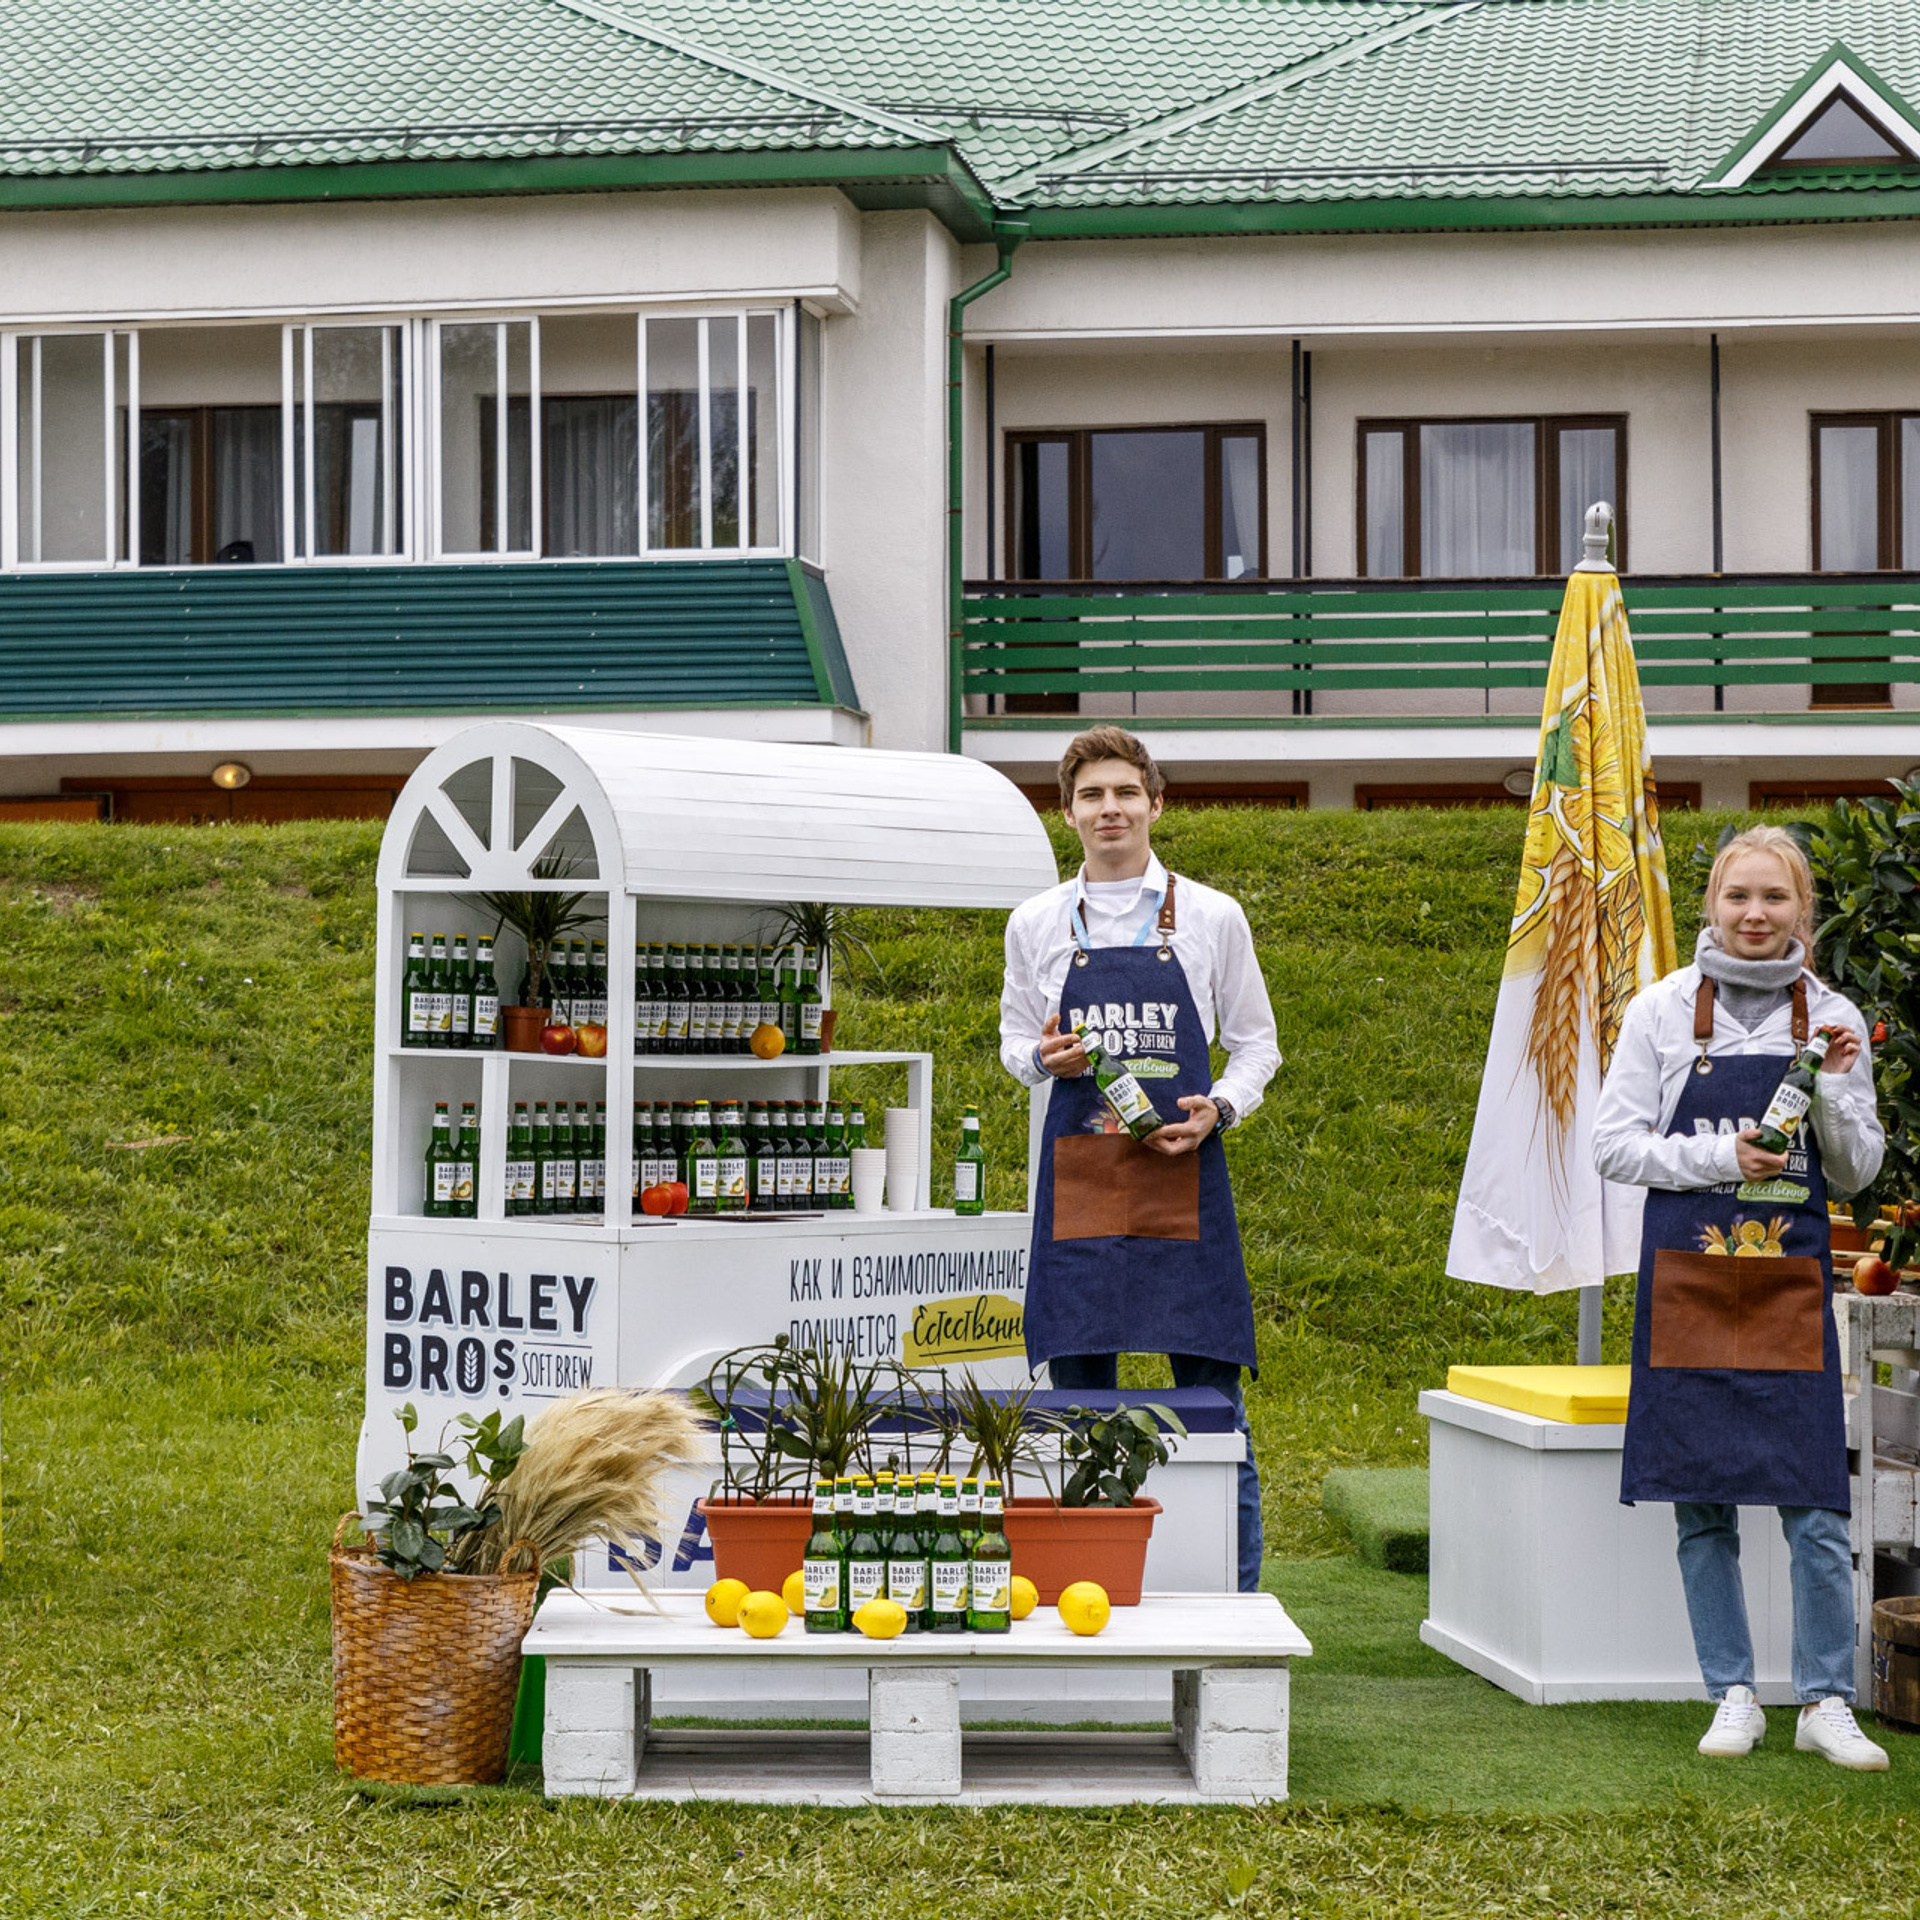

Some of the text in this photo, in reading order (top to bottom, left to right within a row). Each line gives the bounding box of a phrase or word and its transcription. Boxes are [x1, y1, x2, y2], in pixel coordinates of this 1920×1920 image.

[1069, 1002, 1178, 1031] BARLEY
[1693, 1117, 1809, 1150] BARY
[790, 1249, 1026, 1302] КАК И ВЗАИМОПОНИМАНИЕ
[384, 1266, 596, 1333] BARLEY
[790, 1313, 897, 1360] ПОЛУЧАЕТСЯ
[522, 1352, 553, 1387] SOFT
[555, 1355, 593, 1390] BREW
